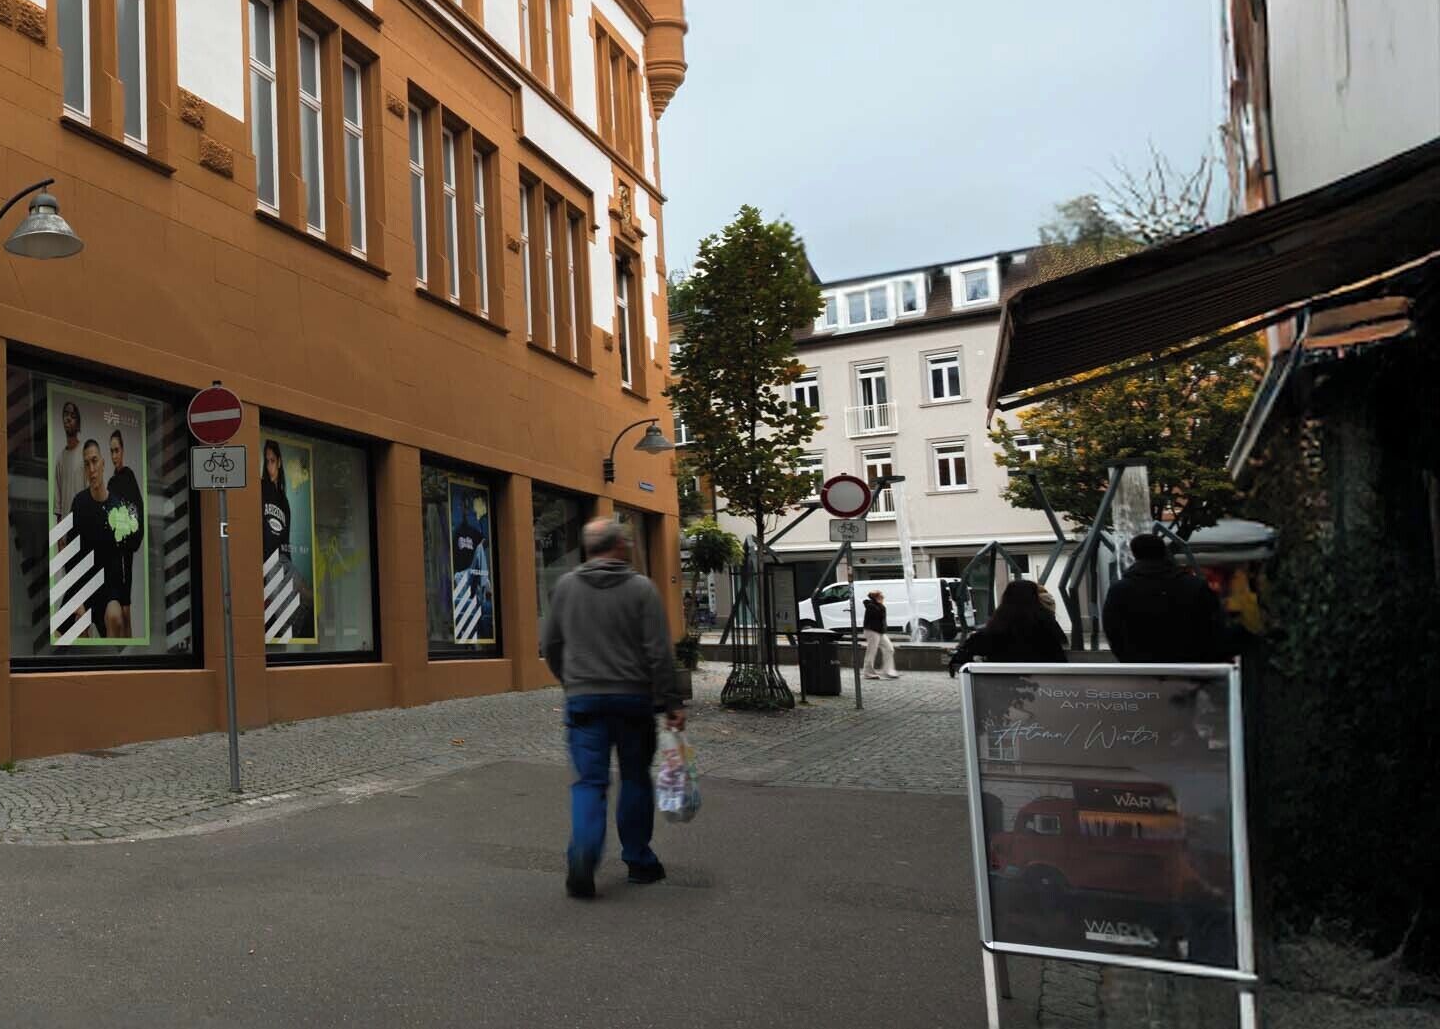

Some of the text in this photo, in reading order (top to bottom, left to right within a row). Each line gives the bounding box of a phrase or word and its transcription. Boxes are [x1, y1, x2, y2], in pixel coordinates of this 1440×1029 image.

[211, 475, 228, 484] frei
[1038, 688, 1160, 700] New Season
[1059, 700, 1139, 712] Arrivals
